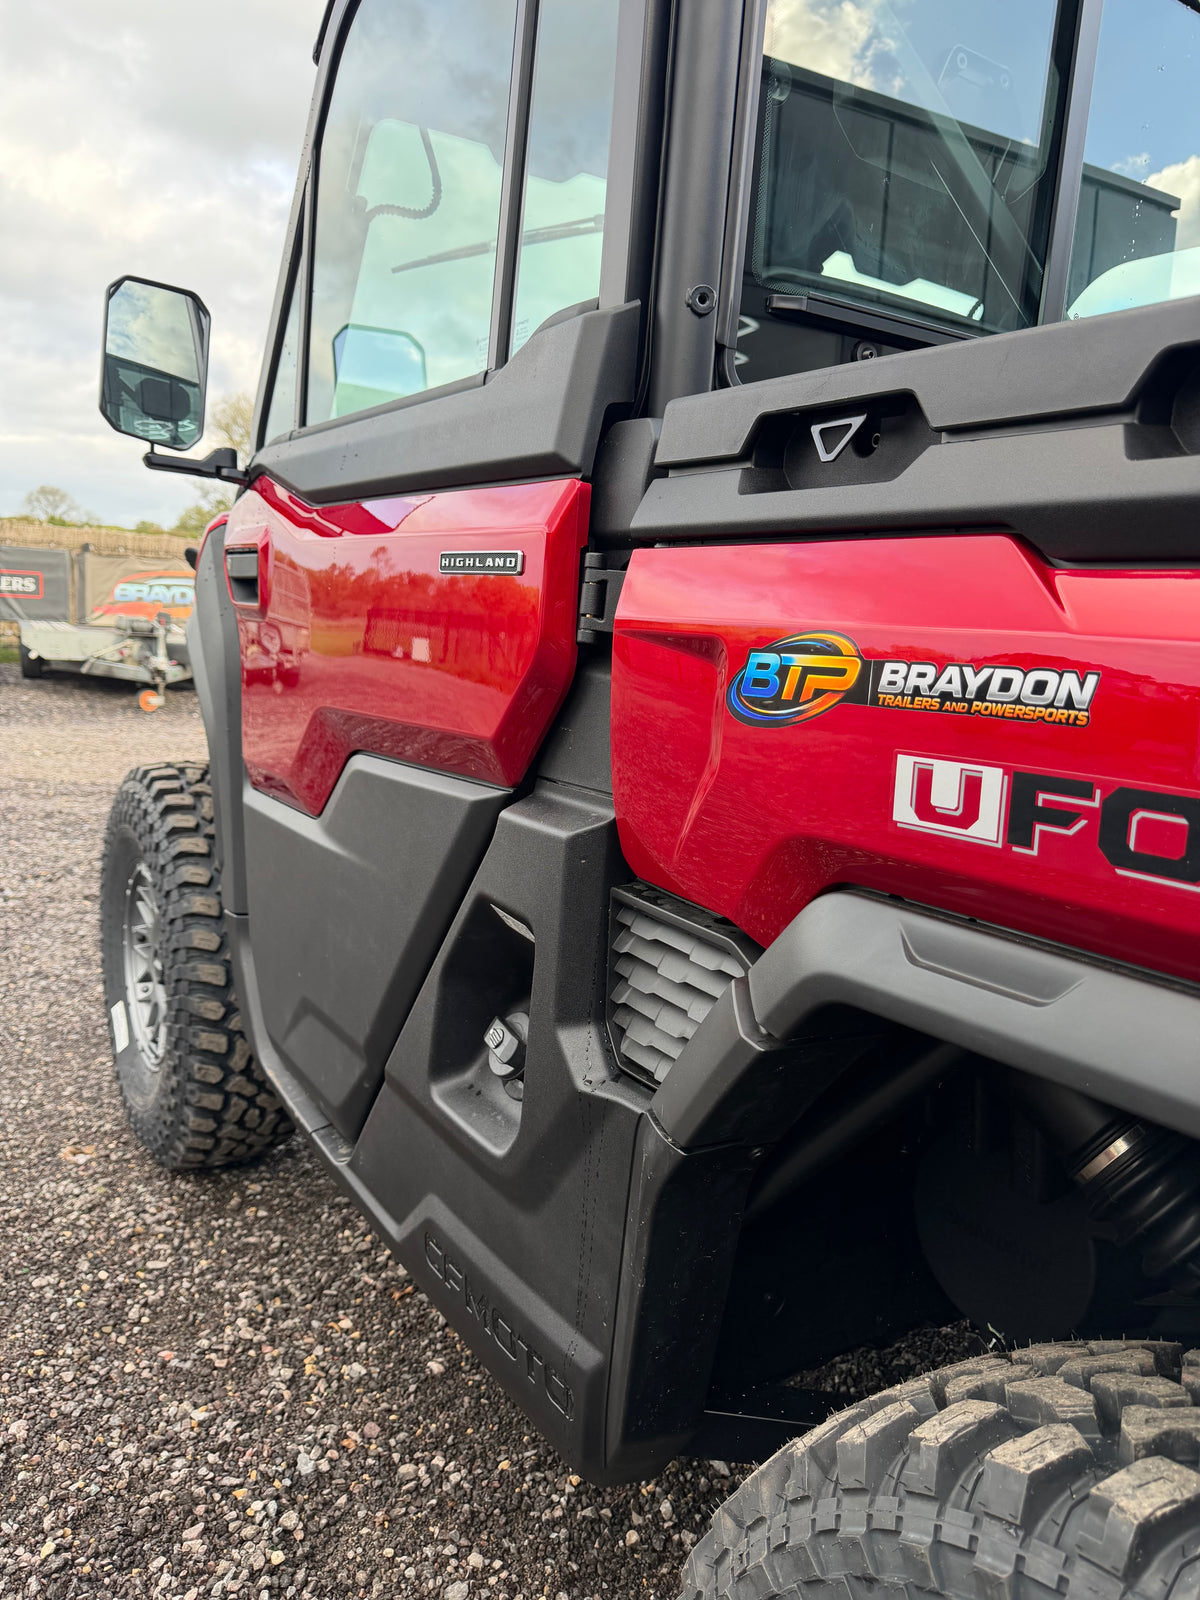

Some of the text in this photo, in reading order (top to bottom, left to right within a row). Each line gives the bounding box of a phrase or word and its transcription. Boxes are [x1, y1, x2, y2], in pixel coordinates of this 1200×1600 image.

[441, 557, 516, 567] HIGHLAND
[0, 576, 36, 592] ERS
[741, 652, 861, 703] BTP
[877, 661, 1100, 709] BRAYDON
[877, 693, 1089, 726] TRAILERS AND POWERSPORTS
[425, 1232, 574, 1421] CFMOTO
